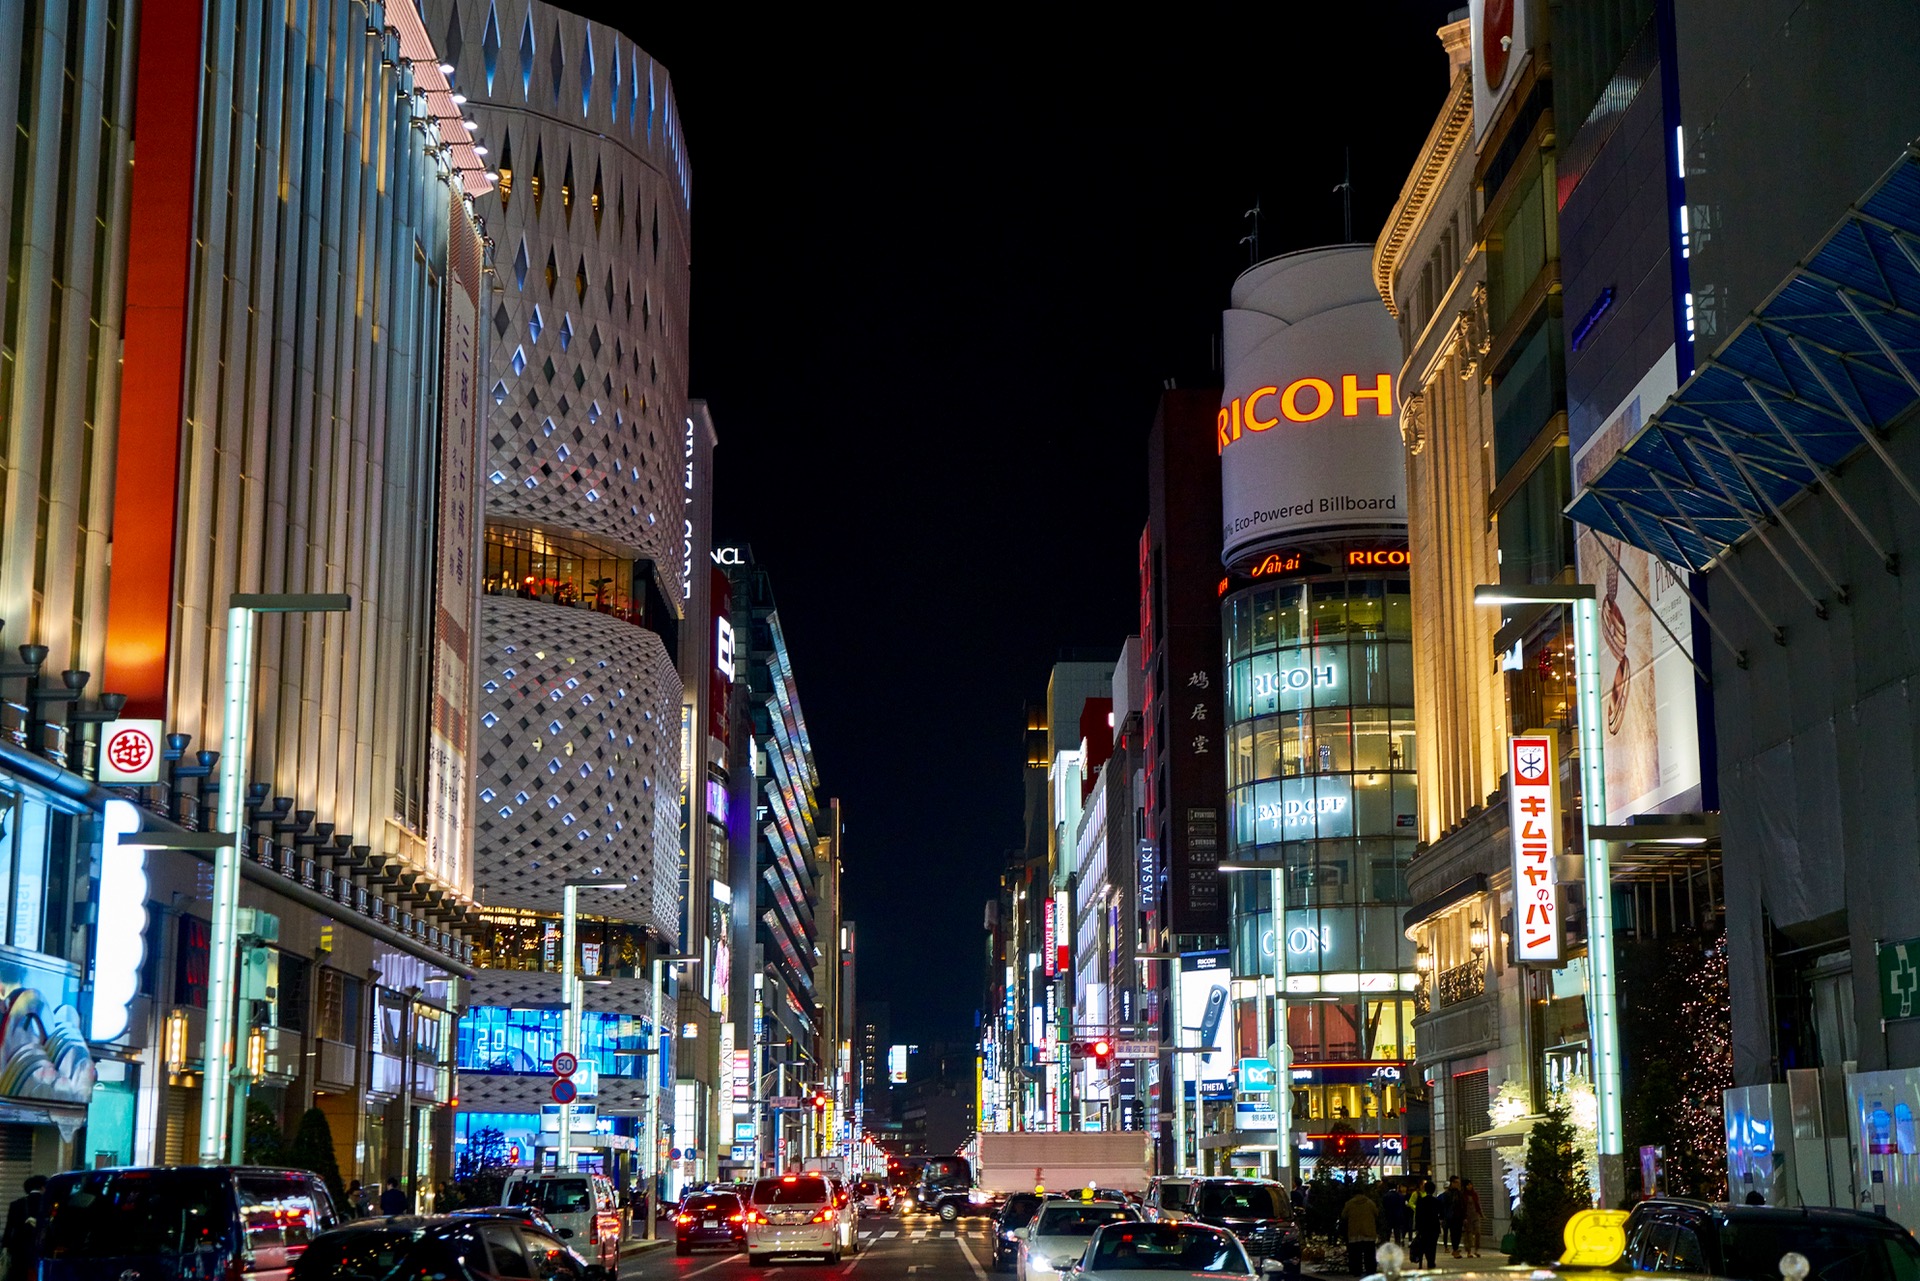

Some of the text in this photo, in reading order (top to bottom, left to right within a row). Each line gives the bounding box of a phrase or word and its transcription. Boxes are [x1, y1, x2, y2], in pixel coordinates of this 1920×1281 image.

[1218, 373, 1393, 456] RICOH
[1235, 500, 1314, 532] Eco-Powered
[1319, 495, 1396, 513] Billboard
[1252, 664, 1336, 698] RICOH
[1187, 670, 1210, 754] 鳩居堂
[113, 734, 148, 767] 越
[1252, 797, 1345, 822] RAND OFF
[1142, 846, 1154, 904] TASAKI
[1520, 795, 1554, 949] キムラヤのパン
[557, 1059, 573, 1071] 50
[723, 1037, 733, 1115] GINZA CORE
[1202, 1083, 1225, 1092] THETA
[1252, 1114, 1276, 1122] 銀座駅
